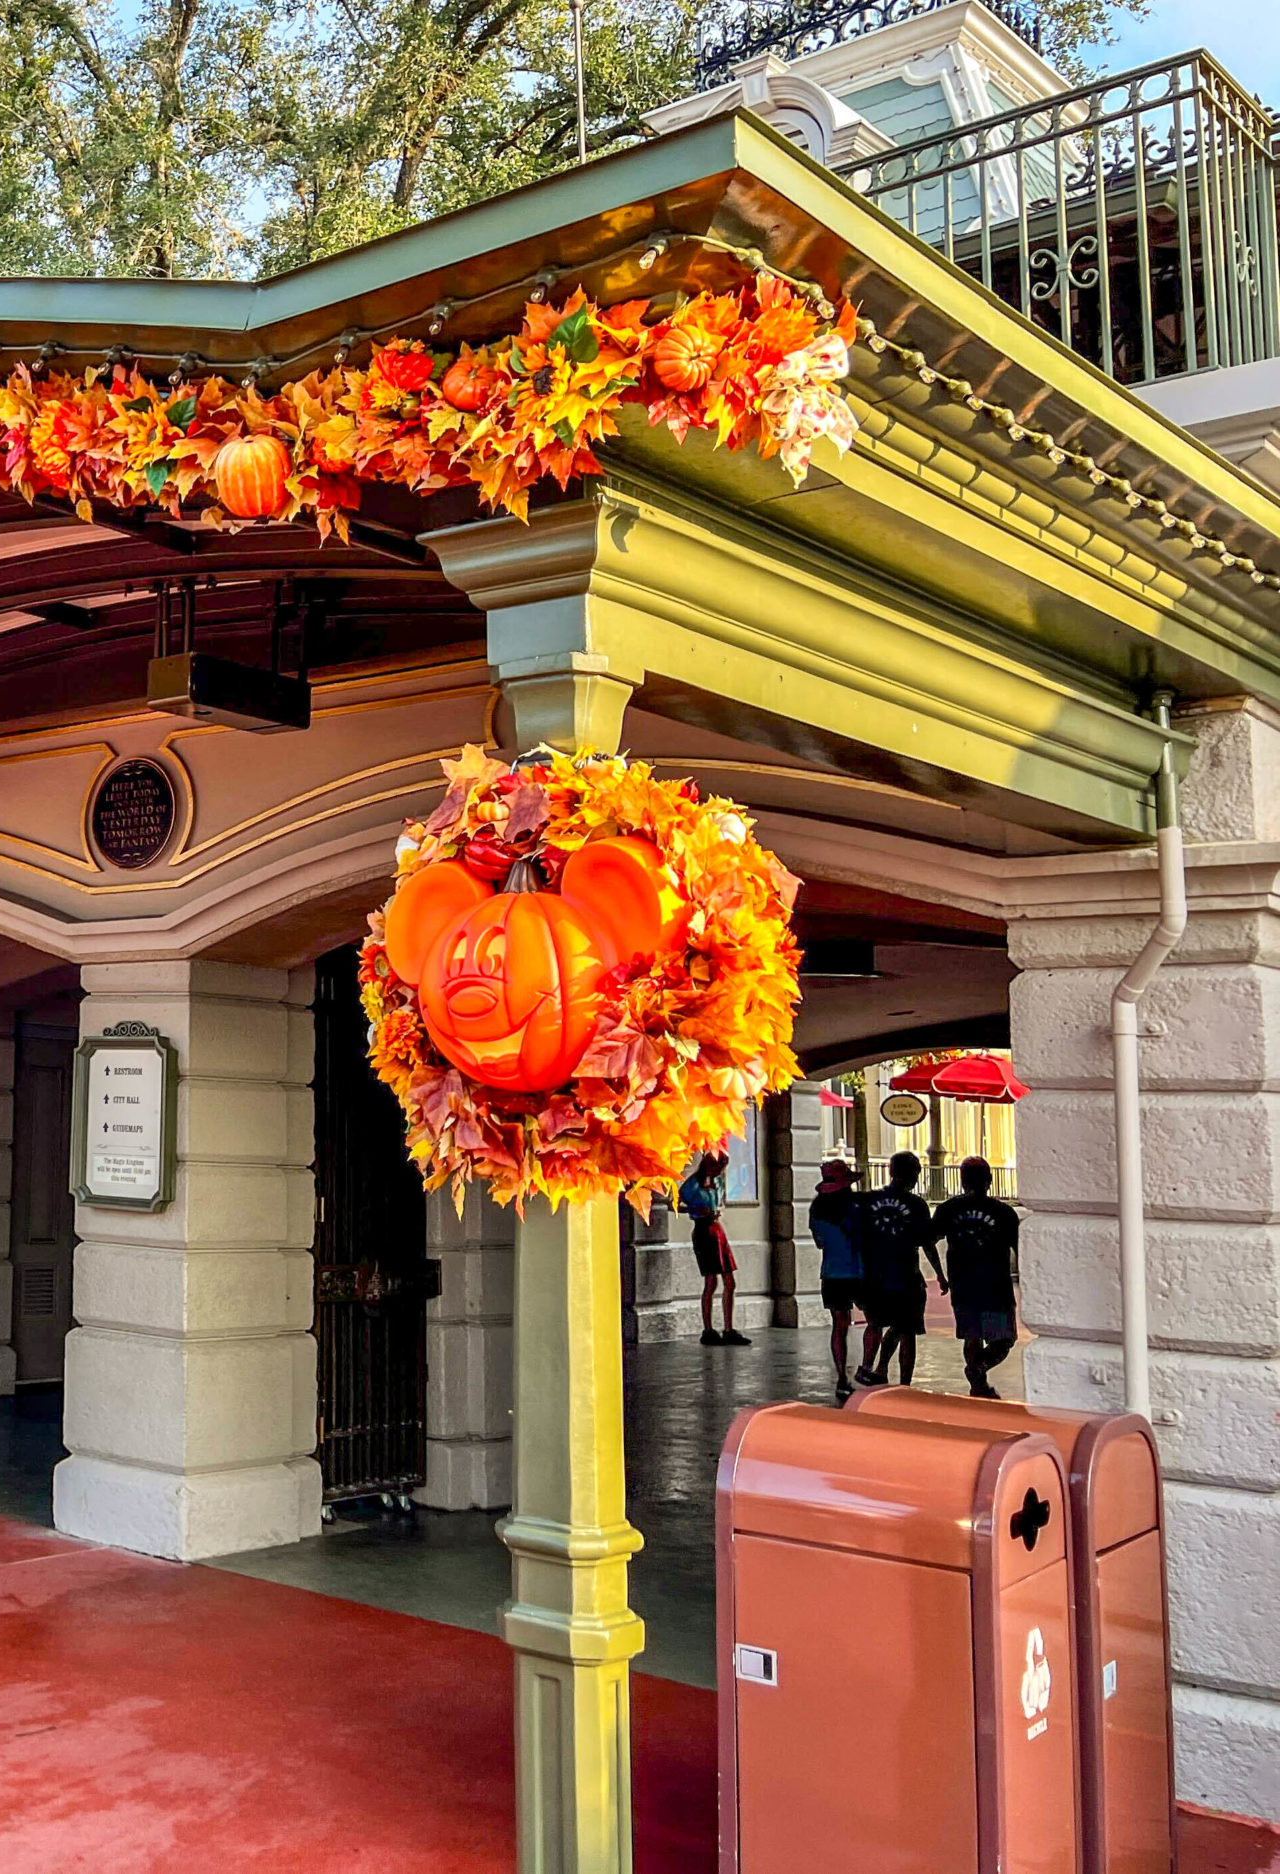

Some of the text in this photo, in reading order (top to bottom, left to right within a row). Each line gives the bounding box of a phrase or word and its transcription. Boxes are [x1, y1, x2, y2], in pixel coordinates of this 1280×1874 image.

[133, 788, 160, 798] TODAY
[100, 804, 166, 820] THE WORLD OF
[120, 837, 160, 848] FANTASY
[113, 1067, 143, 1076] RESTROOM
[112, 1095, 141, 1105] CITY HALL
[112, 1124, 144, 1133] GUIDEMAPS
